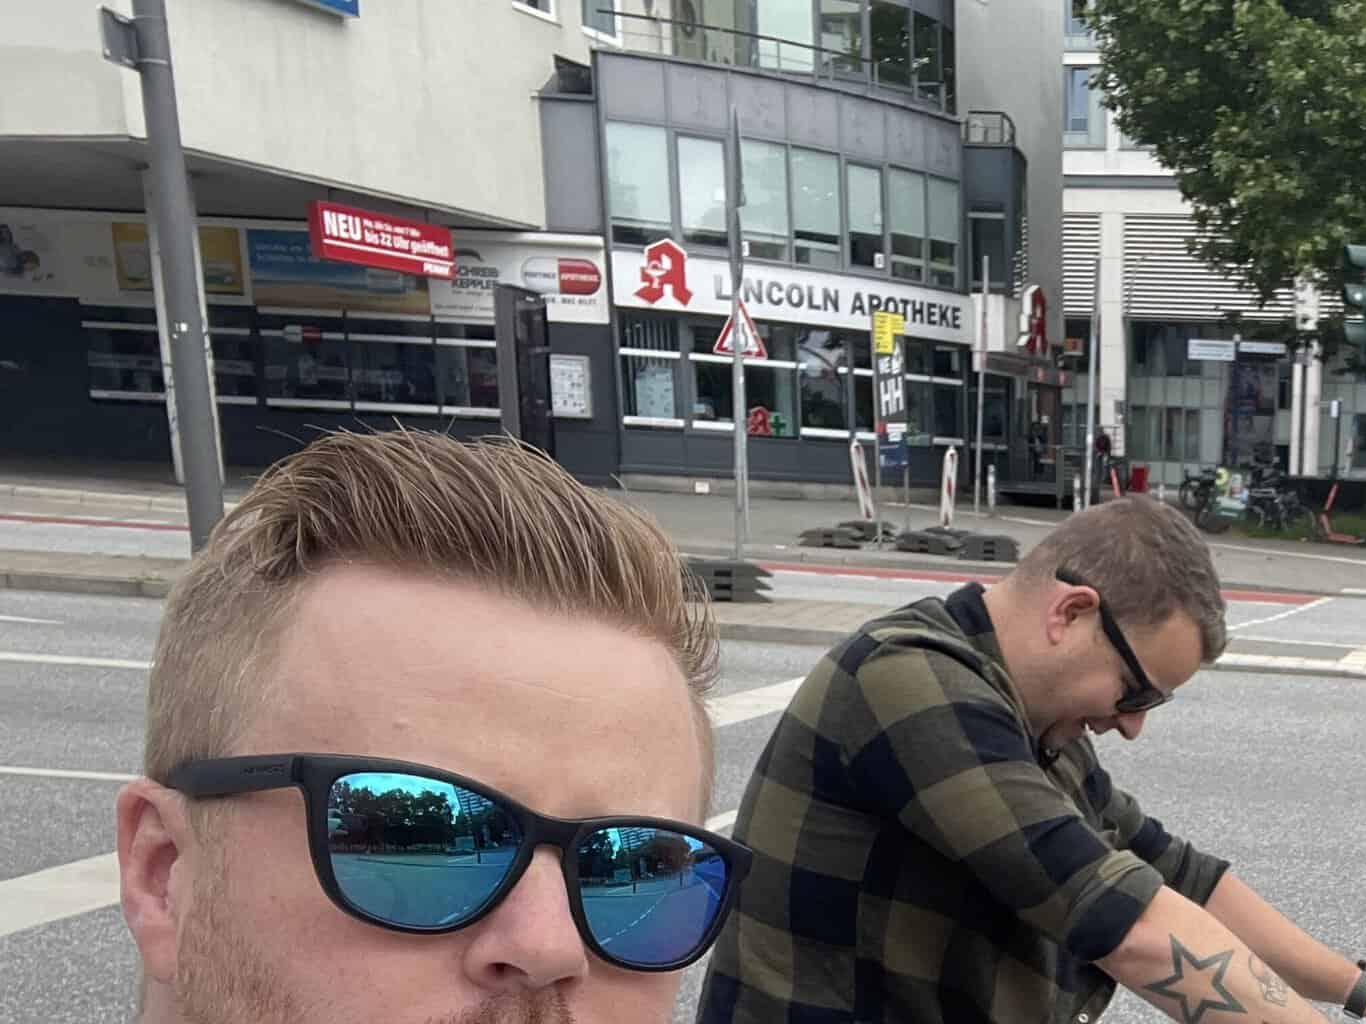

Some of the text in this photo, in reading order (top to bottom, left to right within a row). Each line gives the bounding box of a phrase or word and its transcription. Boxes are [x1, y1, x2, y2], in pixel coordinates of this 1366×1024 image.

[322, 210, 363, 241] NEU
[364, 228, 379, 245] bis
[380, 232, 392, 248] 22
[393, 235, 409, 250] Uhr
[713, 274, 961, 330] LNCOLN APOTHEKE
